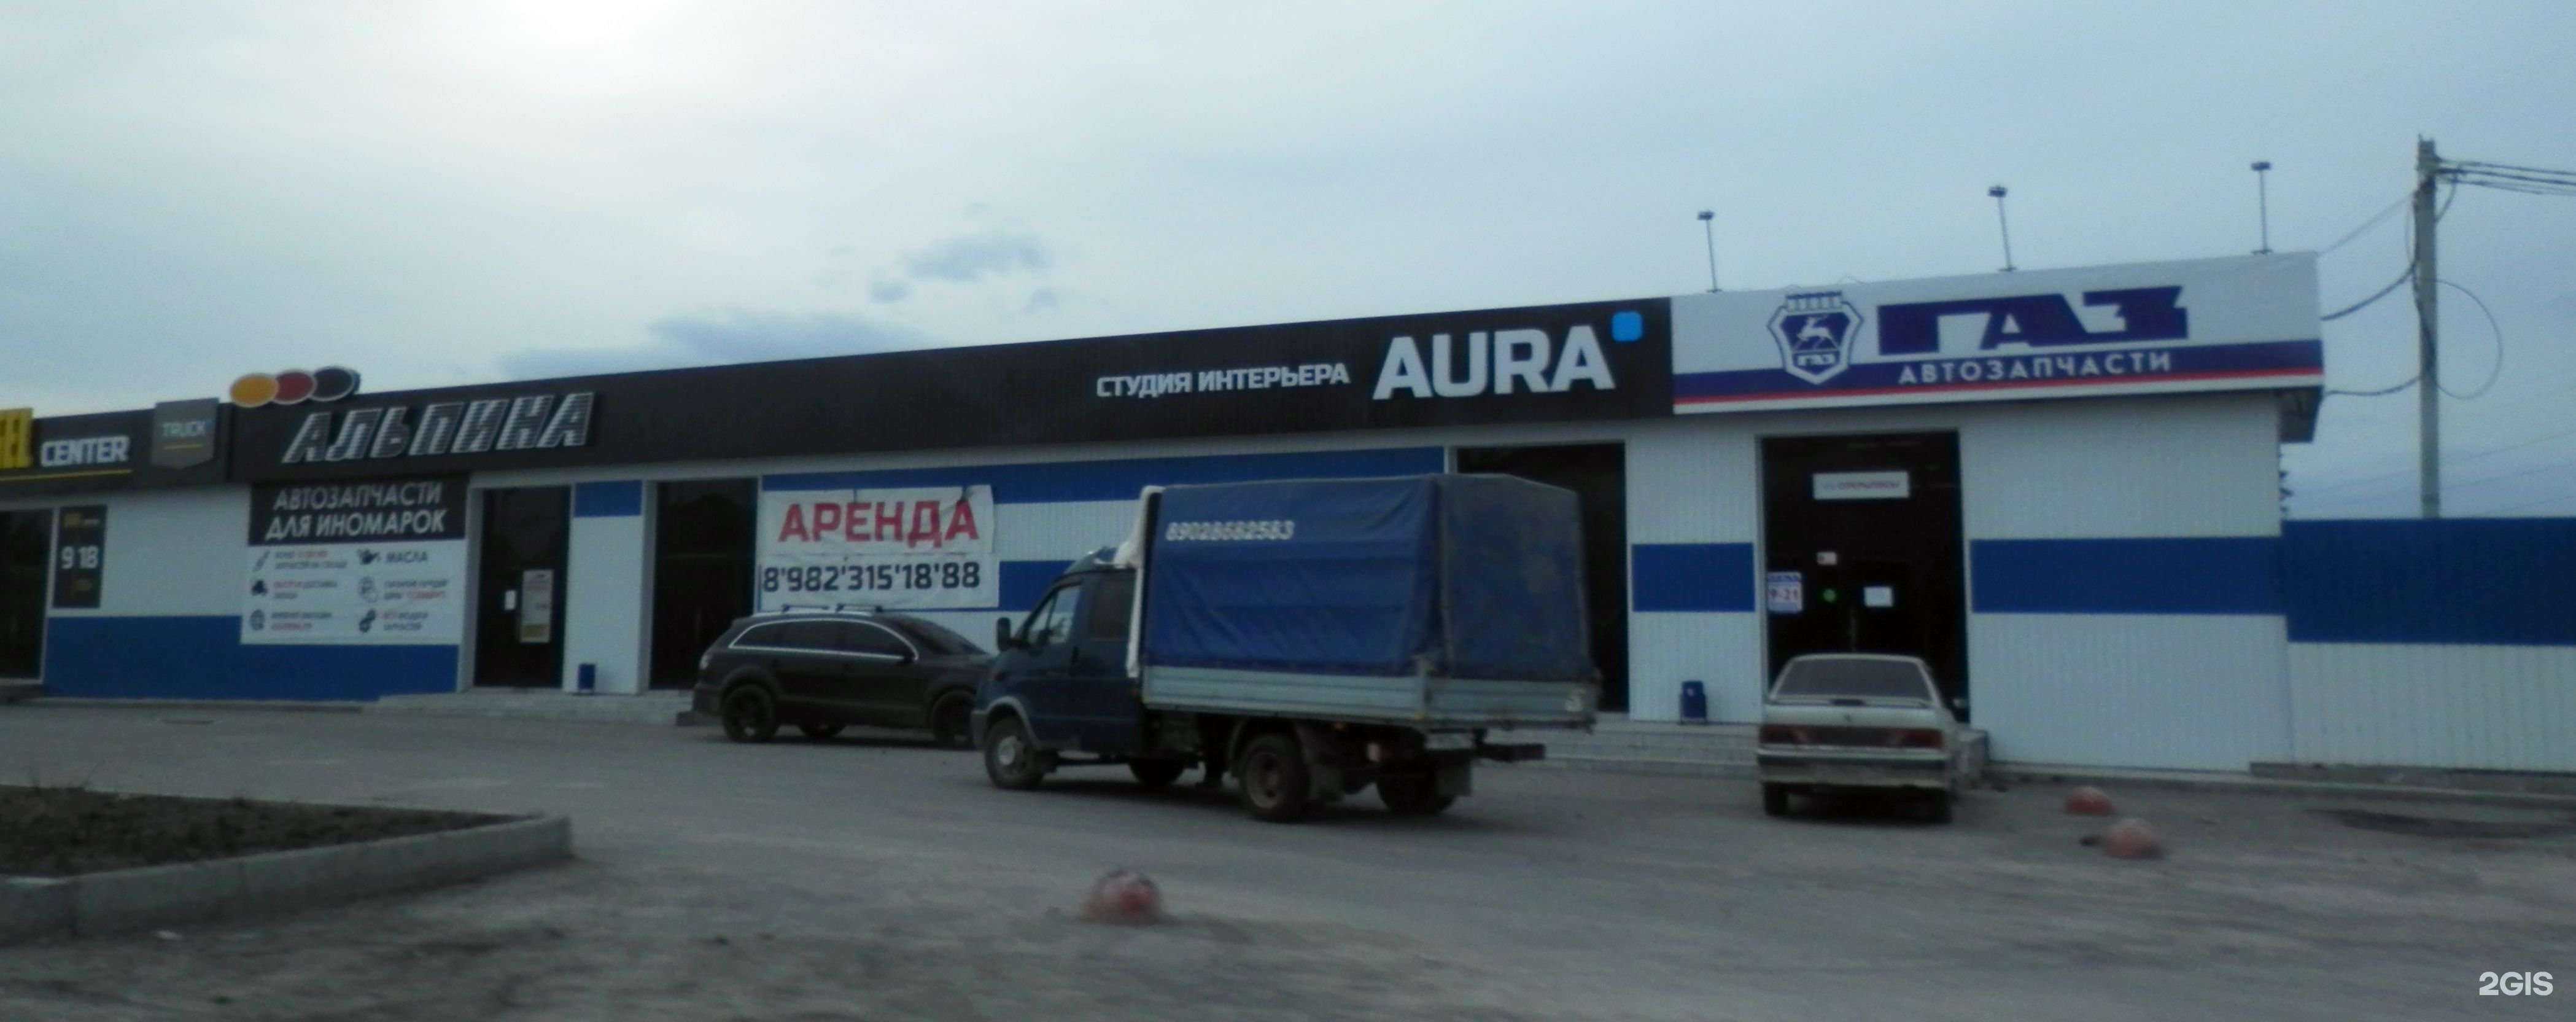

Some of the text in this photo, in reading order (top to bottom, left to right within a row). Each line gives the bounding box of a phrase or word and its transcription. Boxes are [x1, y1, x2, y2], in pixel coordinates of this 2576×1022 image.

[1877, 286, 2188, 356] ГАЗ
[1373, 326, 1616, 400] AURA
[1798, 354, 1836, 366] ГАЗ
[1898, 351, 2171, 384] АВТОЗАПЧАСТИ
[1096, 363, 1350, 398] СТУДИЯ ИНТЕРЬЕРА
[162, 421, 206, 437] TRUCK
[282, 392, 594, 464] АЛЬПИНА
[41, 435, 130, 467] CENTER
[274, 482, 443, 510] АВТОЗАПЧАСТИ
[265, 509, 448, 541] ДЛЯ ИНОМАРОК
[778, 499, 980, 548] АРЕНДА
[61, 545, 98, 569] 9 18
[764, 562, 980, 592] 8'982'315'18'88
